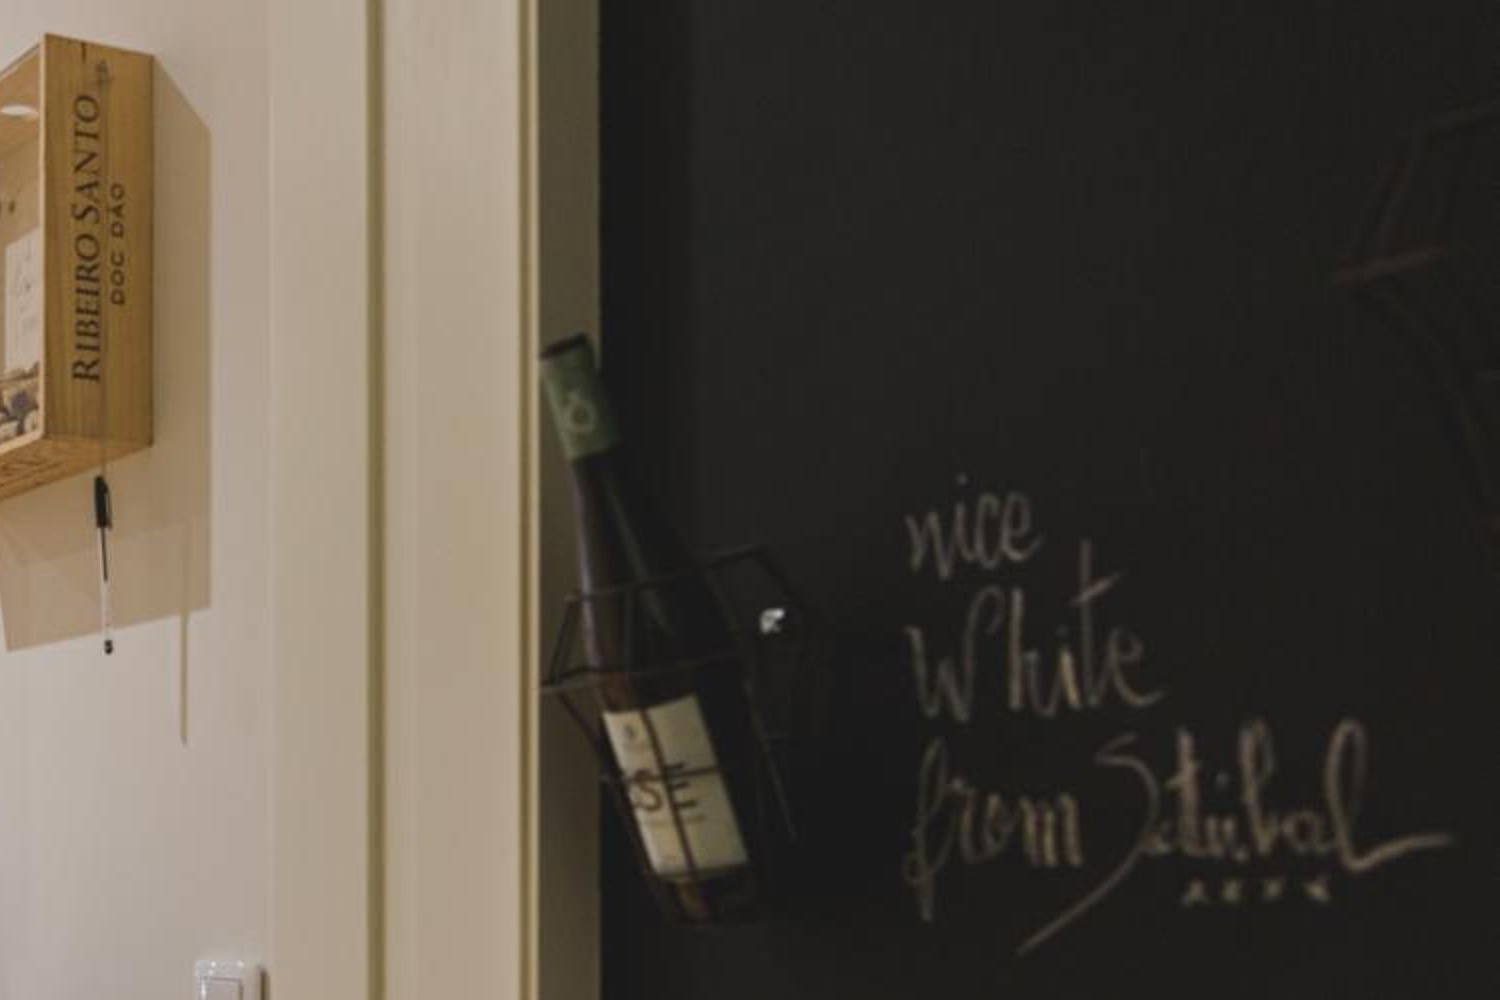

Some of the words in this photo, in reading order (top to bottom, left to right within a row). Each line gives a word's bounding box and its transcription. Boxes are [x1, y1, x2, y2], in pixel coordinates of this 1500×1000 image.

[70, 94, 102, 227] SANTO
[108, 182, 125, 239] DÃO
[71, 232, 101, 384] RIBEIRO
[110, 252, 125, 306] DOC
[904, 472, 1046, 580] nice
[904, 537, 1168, 724] White
[902, 737, 1085, 923] from
